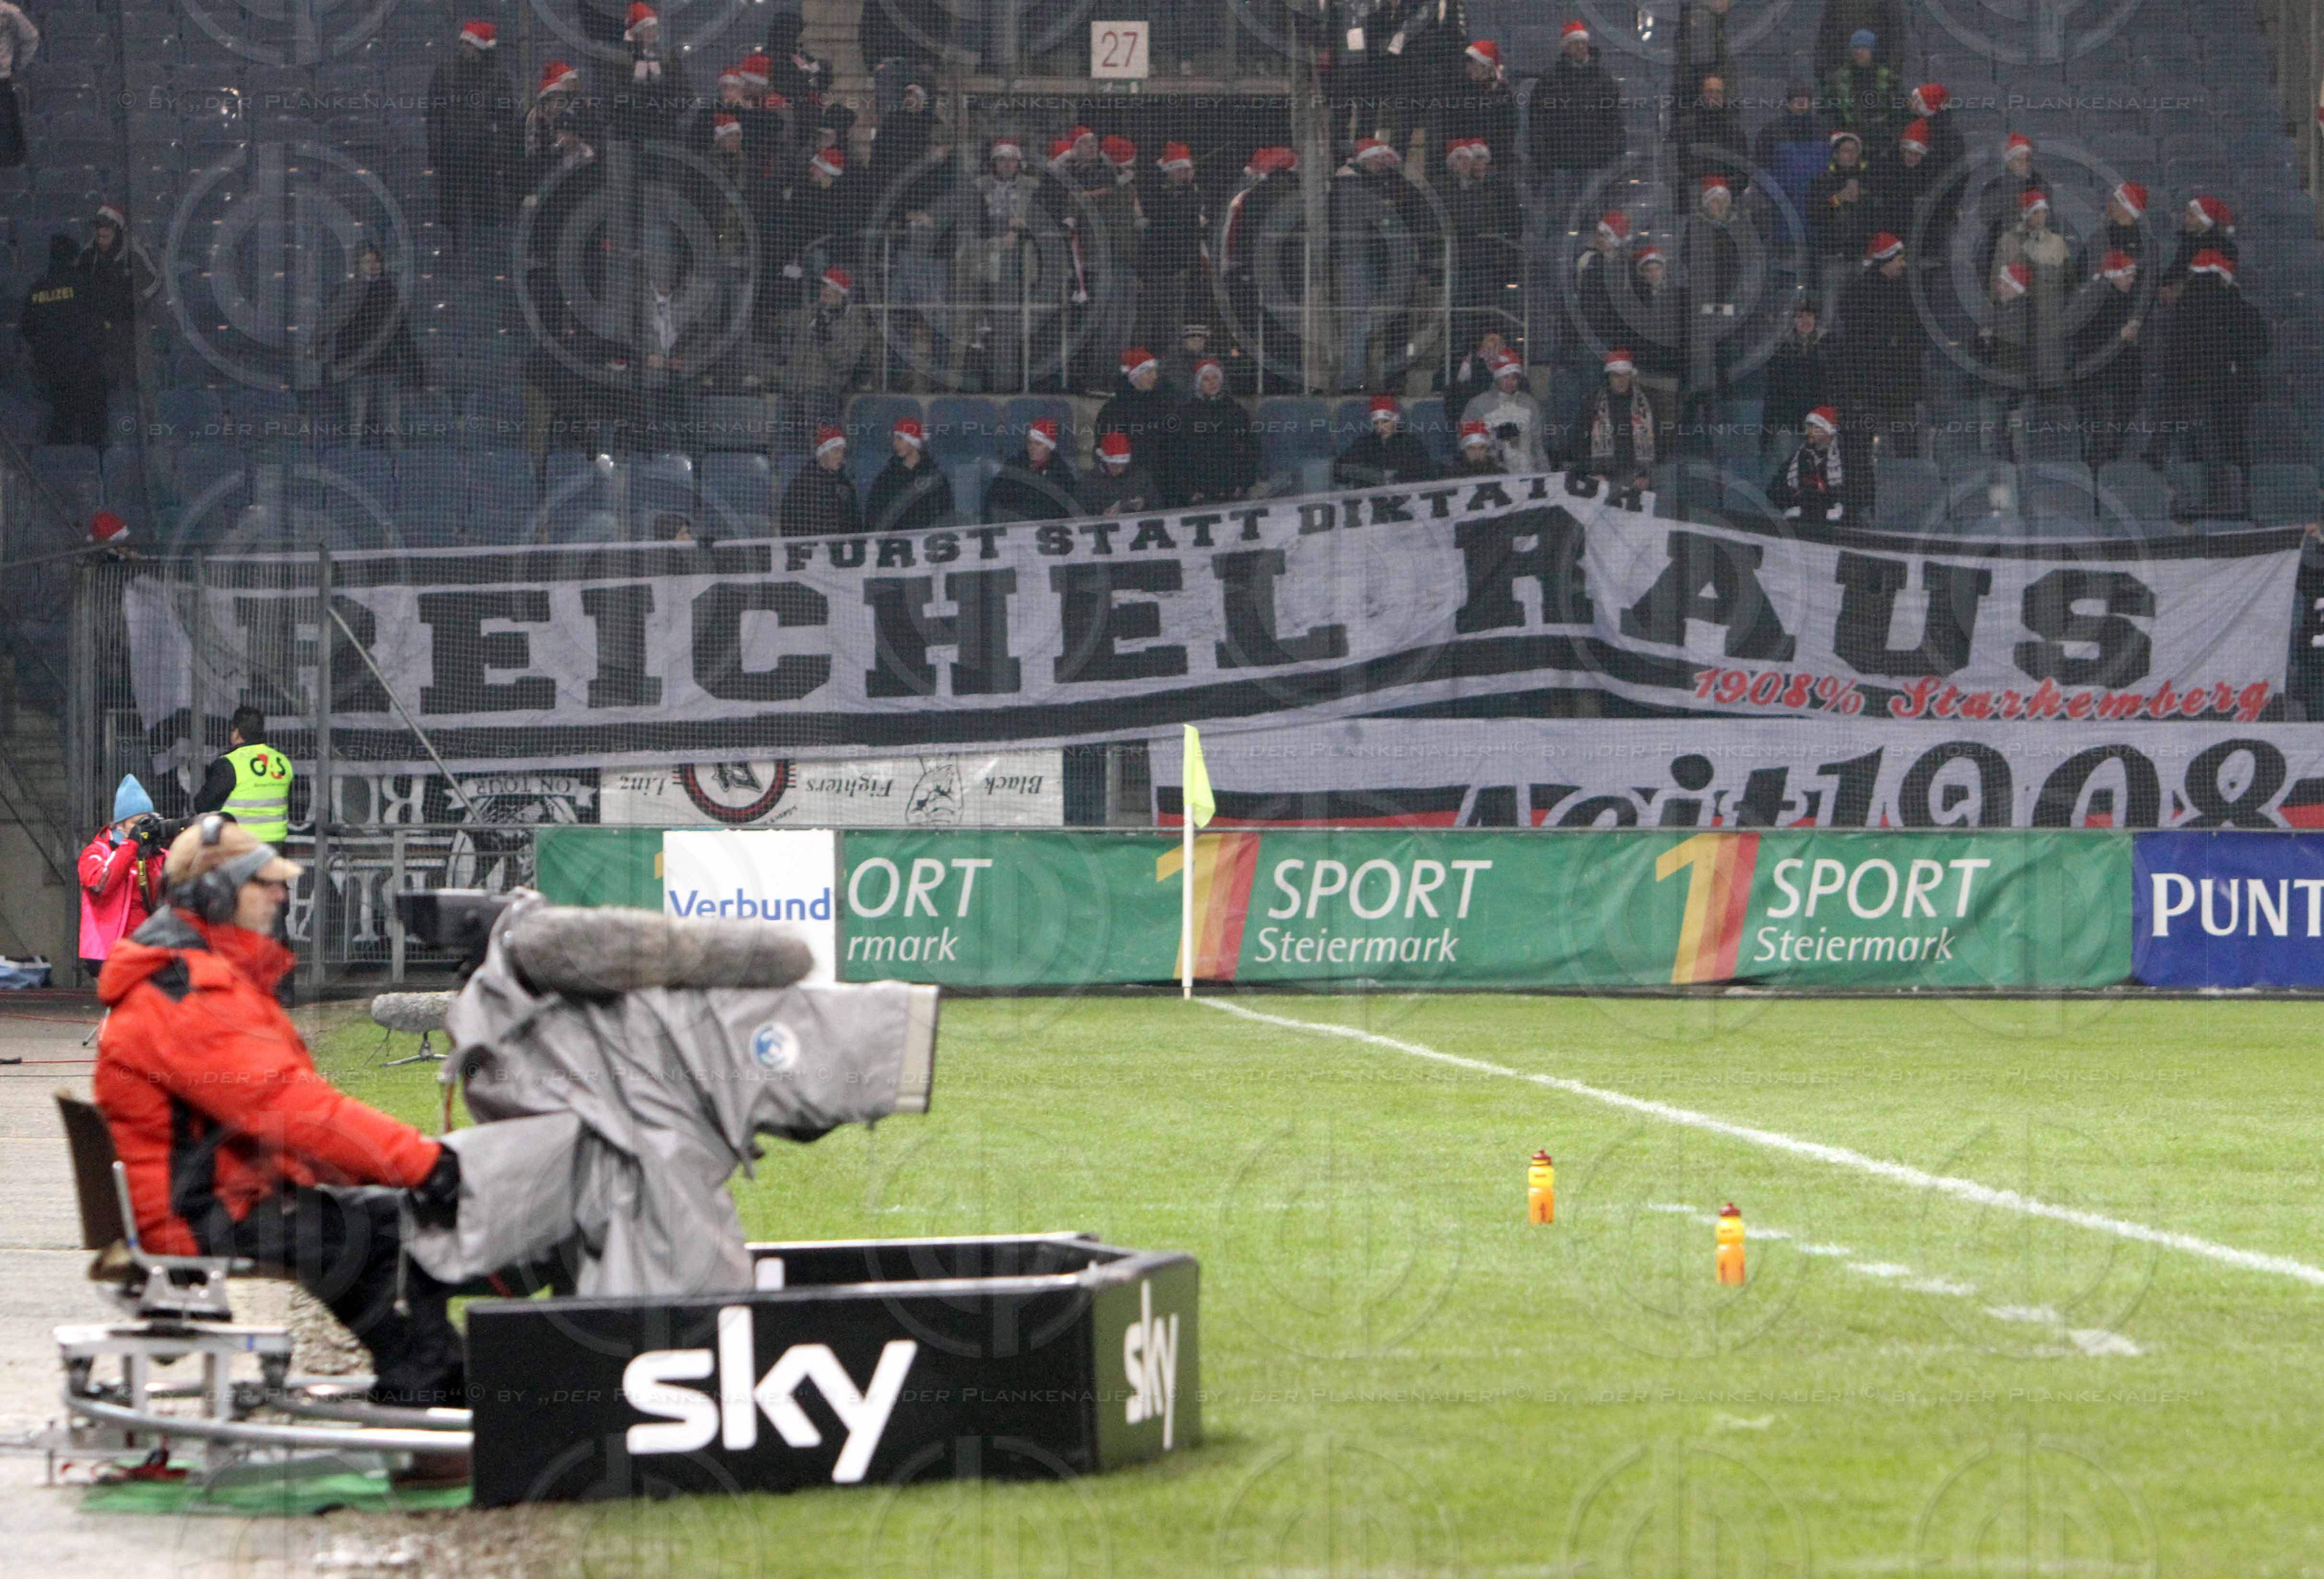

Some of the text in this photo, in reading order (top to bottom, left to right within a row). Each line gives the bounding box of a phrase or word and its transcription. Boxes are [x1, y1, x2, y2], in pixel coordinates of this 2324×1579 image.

[1101, 31, 1138, 67] 27
[1035, 507, 1269, 556] STATT
[1297, 471, 1644, 535] DIKTATOR
[233, 505, 2159, 716] REICHEL RAUS
[1695, 668, 1864, 715] 1908%
[541, 777, 571, 793] ON
[805, 777, 893, 797] Fighters
[983, 776, 1044, 794] Black
[669, 888, 830, 920] Verbund
[1268, 859, 1492, 919] SPORT
[1766, 858, 1991, 918] SPORT
[2150, 873, 2324, 937] PUNT
[1255, 928, 1459, 963] Steiermark
[1754, 927, 1955, 962] Steiermark
[1124, 1279, 1179, 1451] sky
[622, 1306, 918, 1484] sky
